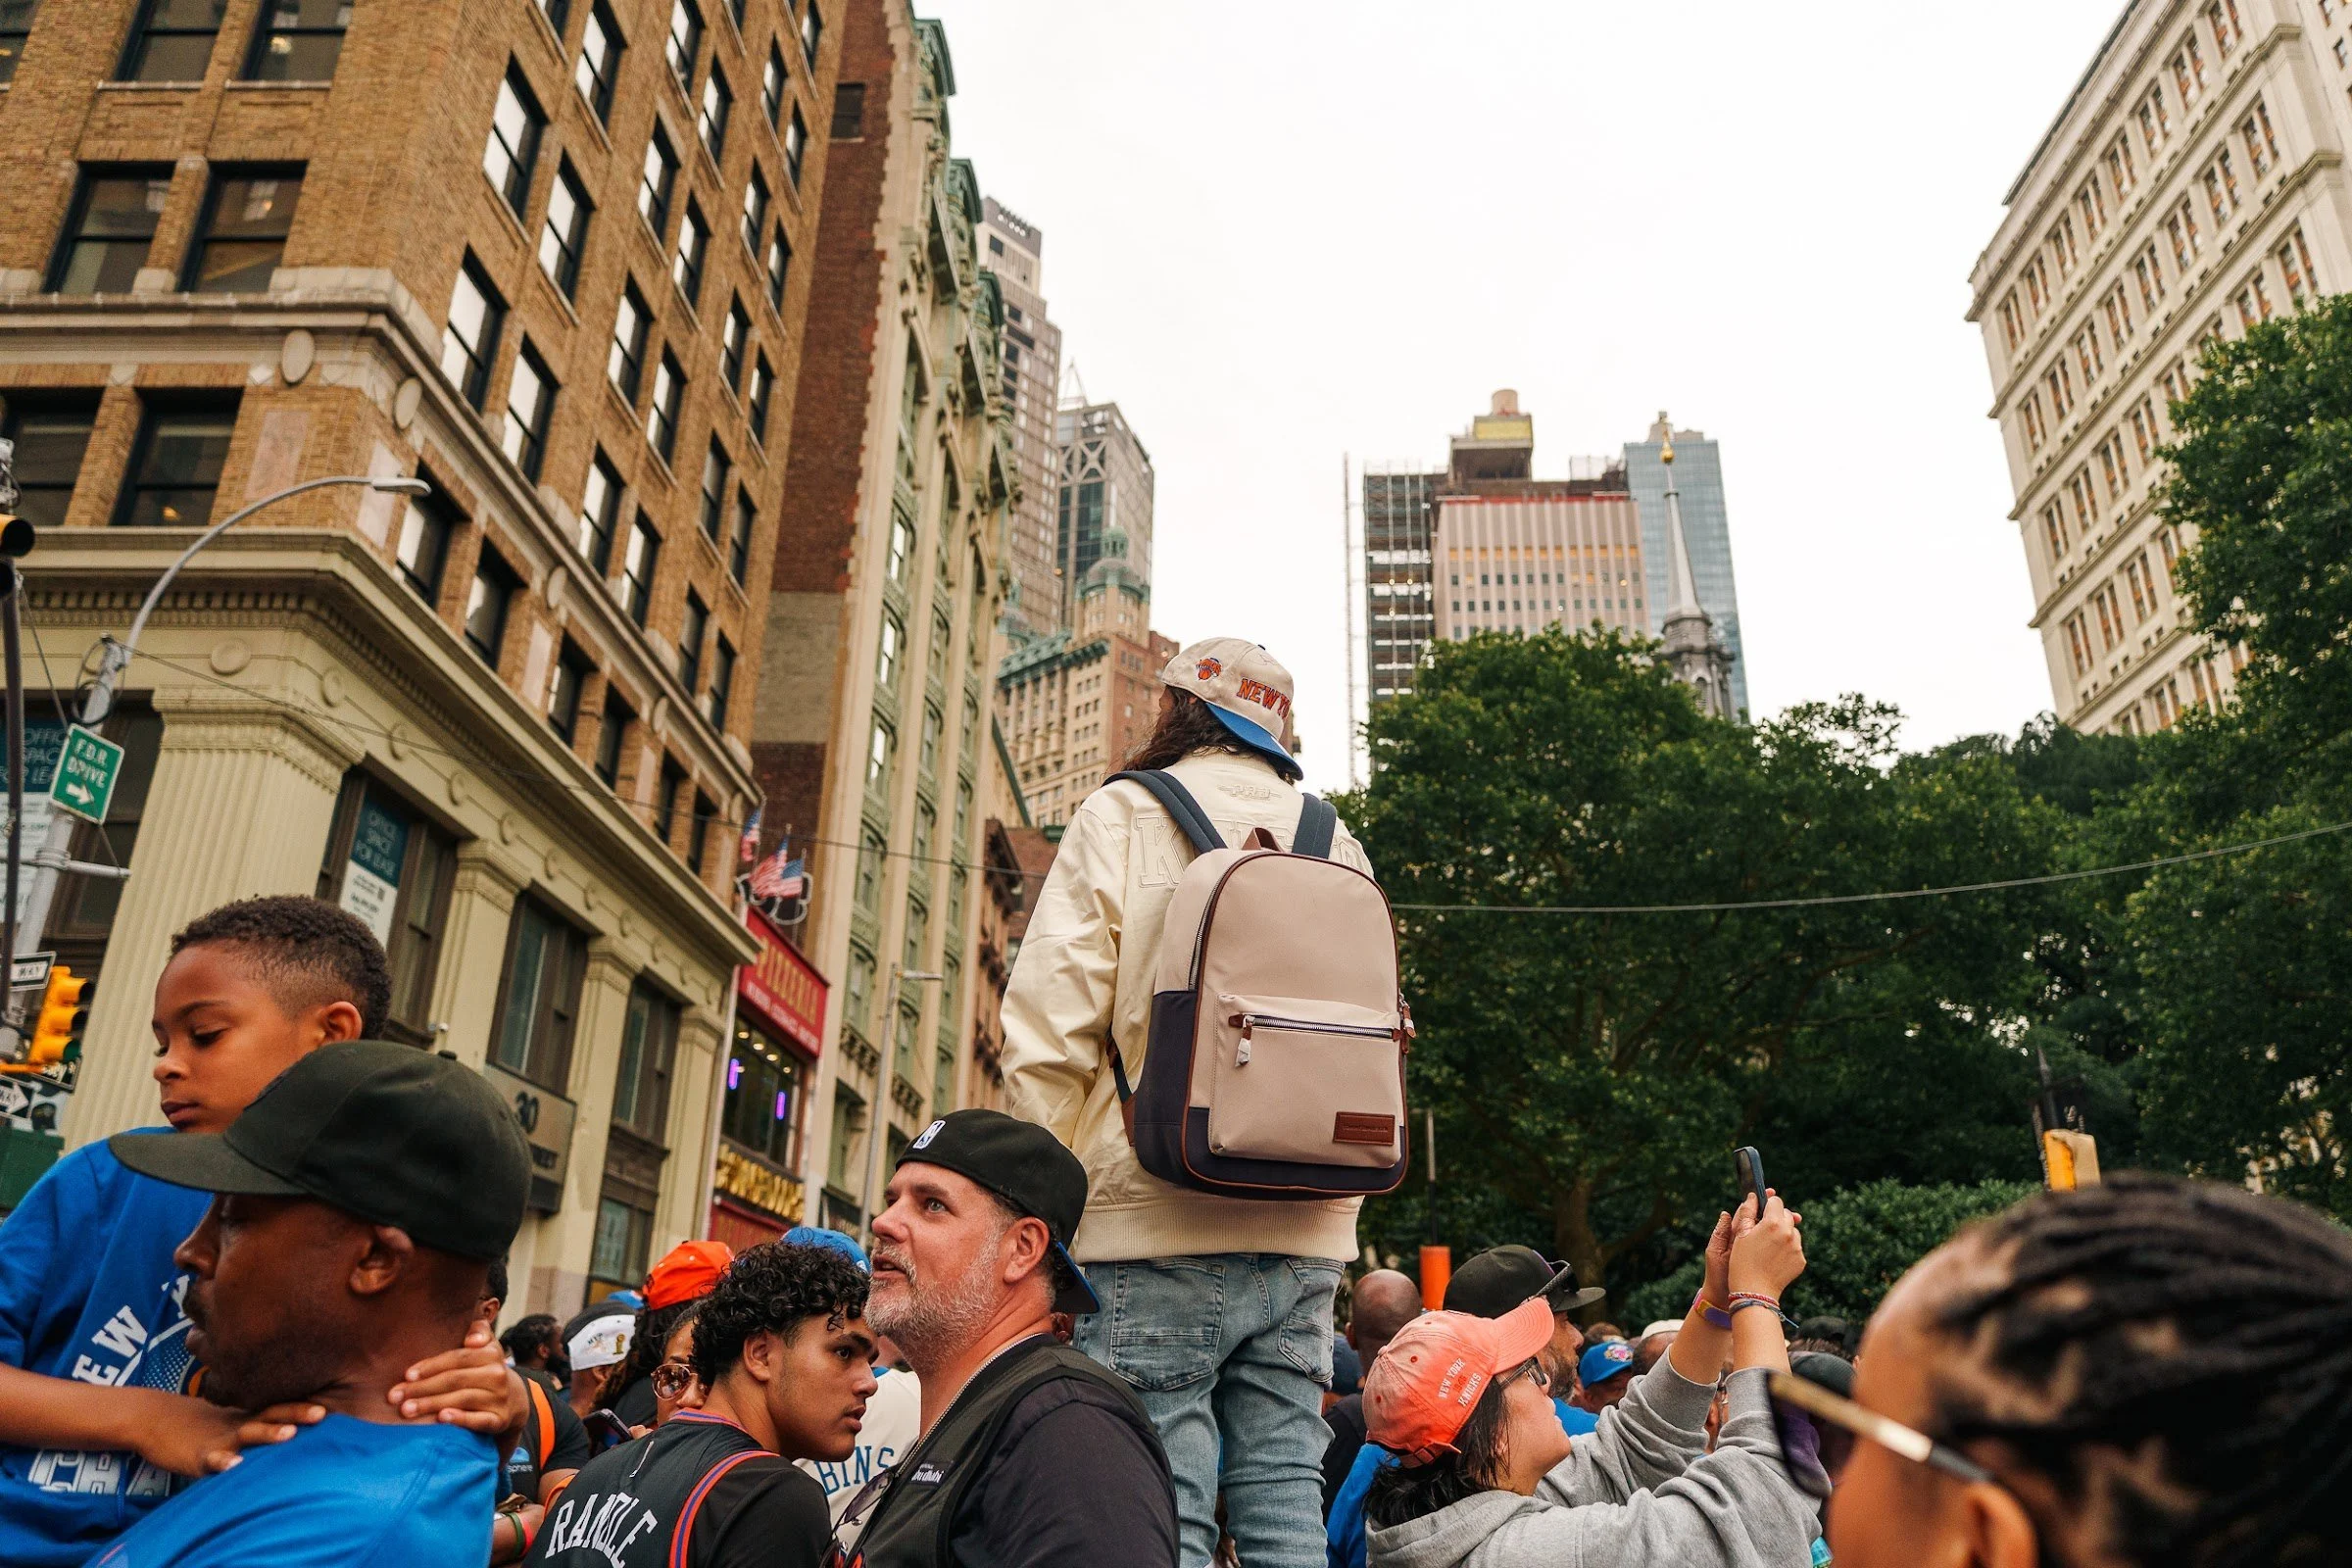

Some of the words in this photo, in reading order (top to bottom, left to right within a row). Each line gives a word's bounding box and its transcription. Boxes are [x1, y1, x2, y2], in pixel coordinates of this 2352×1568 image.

[1236, 678, 1280, 710] NEW
[66, 756, 108, 788] DRIVE
[72, 1304, 149, 1387] EW
[1438, 1378, 1452, 1398] NEW
[1446, 1357, 1465, 1378] YORK
[1457, 1372, 1482, 1407] KNICKS
